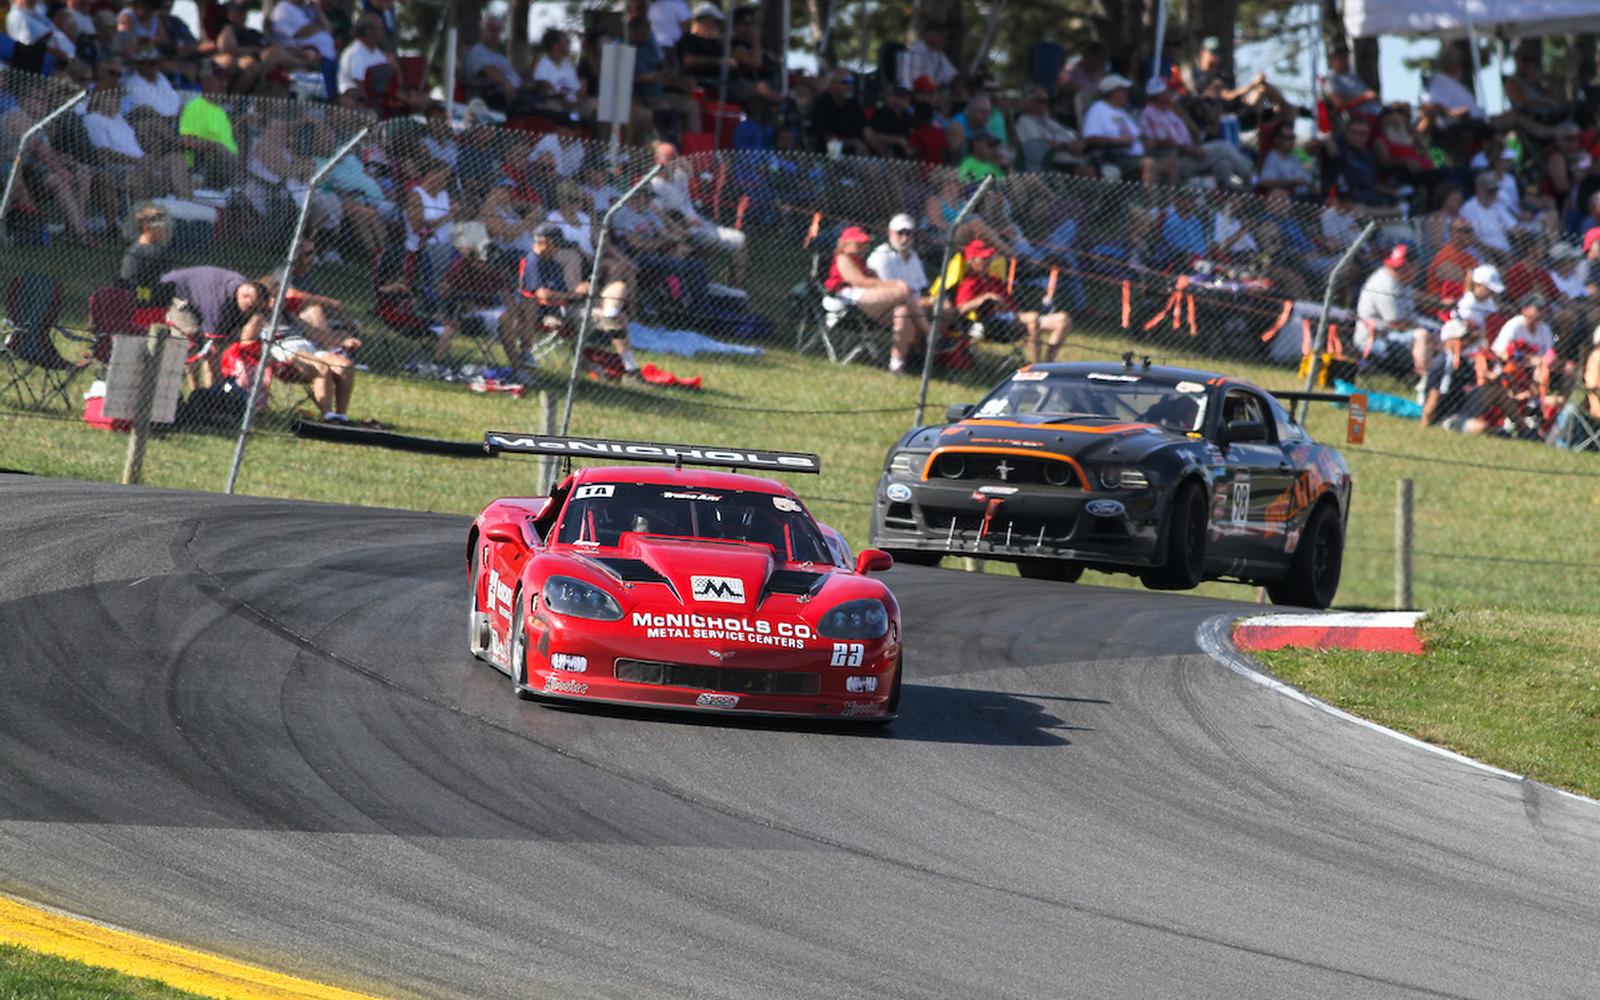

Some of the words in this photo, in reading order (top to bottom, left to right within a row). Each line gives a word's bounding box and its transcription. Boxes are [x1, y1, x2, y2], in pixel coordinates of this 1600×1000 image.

[494, 436, 815, 467] McNICHOLS
[1091, 502, 1119, 514] Ford
[1233, 485, 1249, 521] 98
[632, 612, 771, 634] McNICHOLS
[777, 622, 818, 640] CO.
[647, 628, 691, 639] METAL
[693, 629, 746, 642] SERVICE
[748, 633, 805, 650] CENTERS
[830, 643, 865, 667] 23
